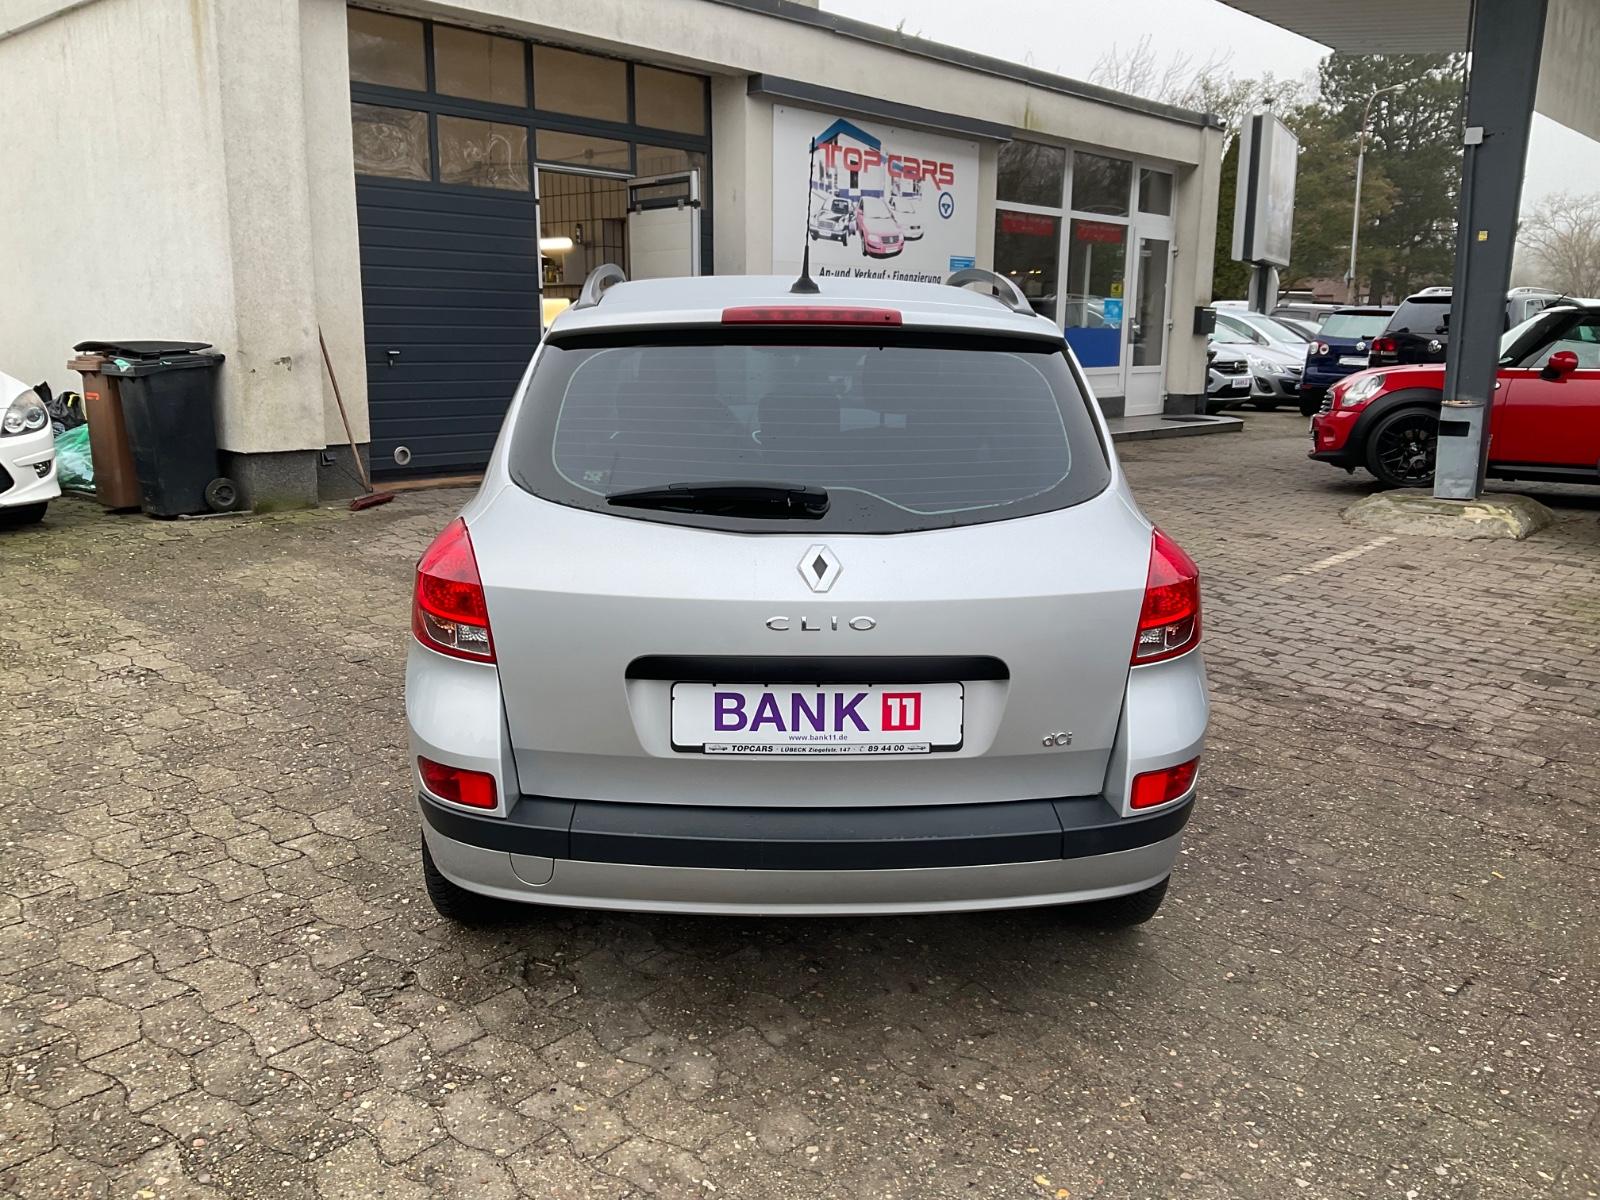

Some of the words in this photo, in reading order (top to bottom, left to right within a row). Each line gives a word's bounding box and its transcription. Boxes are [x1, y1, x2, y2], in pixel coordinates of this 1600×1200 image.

[817, 143, 881, 174] TOP
[854, 268, 887, 280] Verkauf
[892, 270, 942, 285] Finanzierung
[766, 616, 876, 631] CLIO
[714, 692, 869, 732] BANK
[885, 696, 917, 728] 11
[1043, 731, 1073, 747] dCi
[731, 744, 774, 753] TOPCARS
